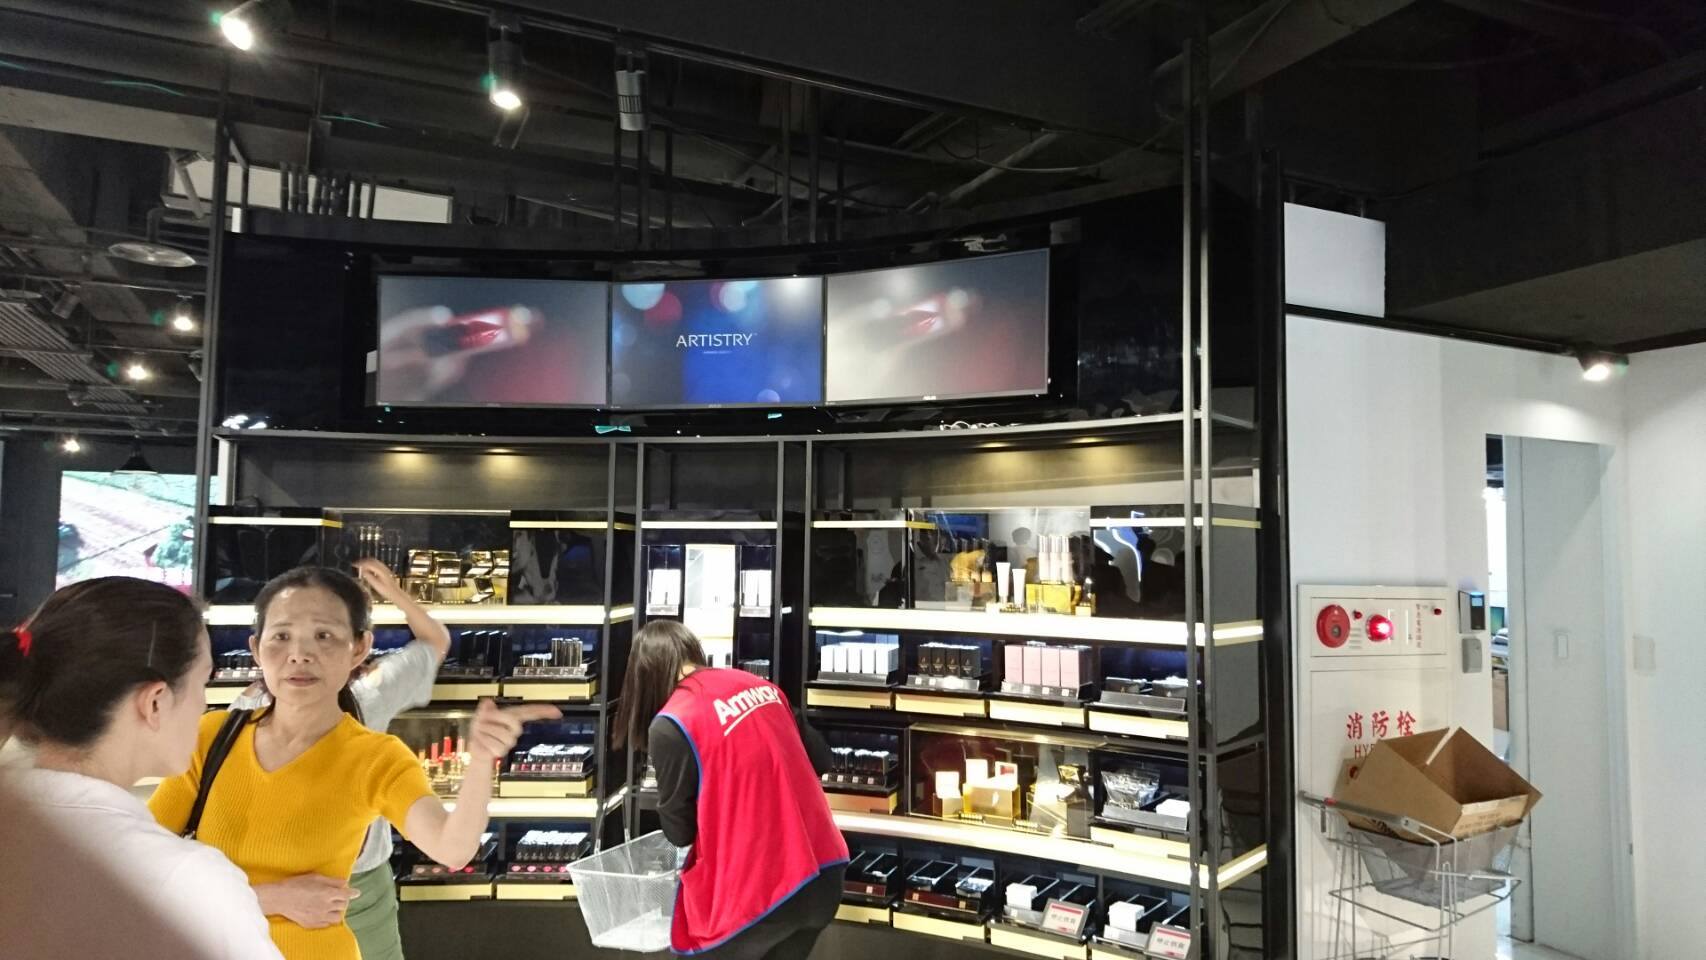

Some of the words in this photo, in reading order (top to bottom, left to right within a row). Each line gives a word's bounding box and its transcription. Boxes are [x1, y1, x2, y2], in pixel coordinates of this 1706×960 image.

[675, 333, 753, 348] ARTISTRY
[713, 685, 782, 726] Amway
[1346, 710, 1416, 740] 消防栓
